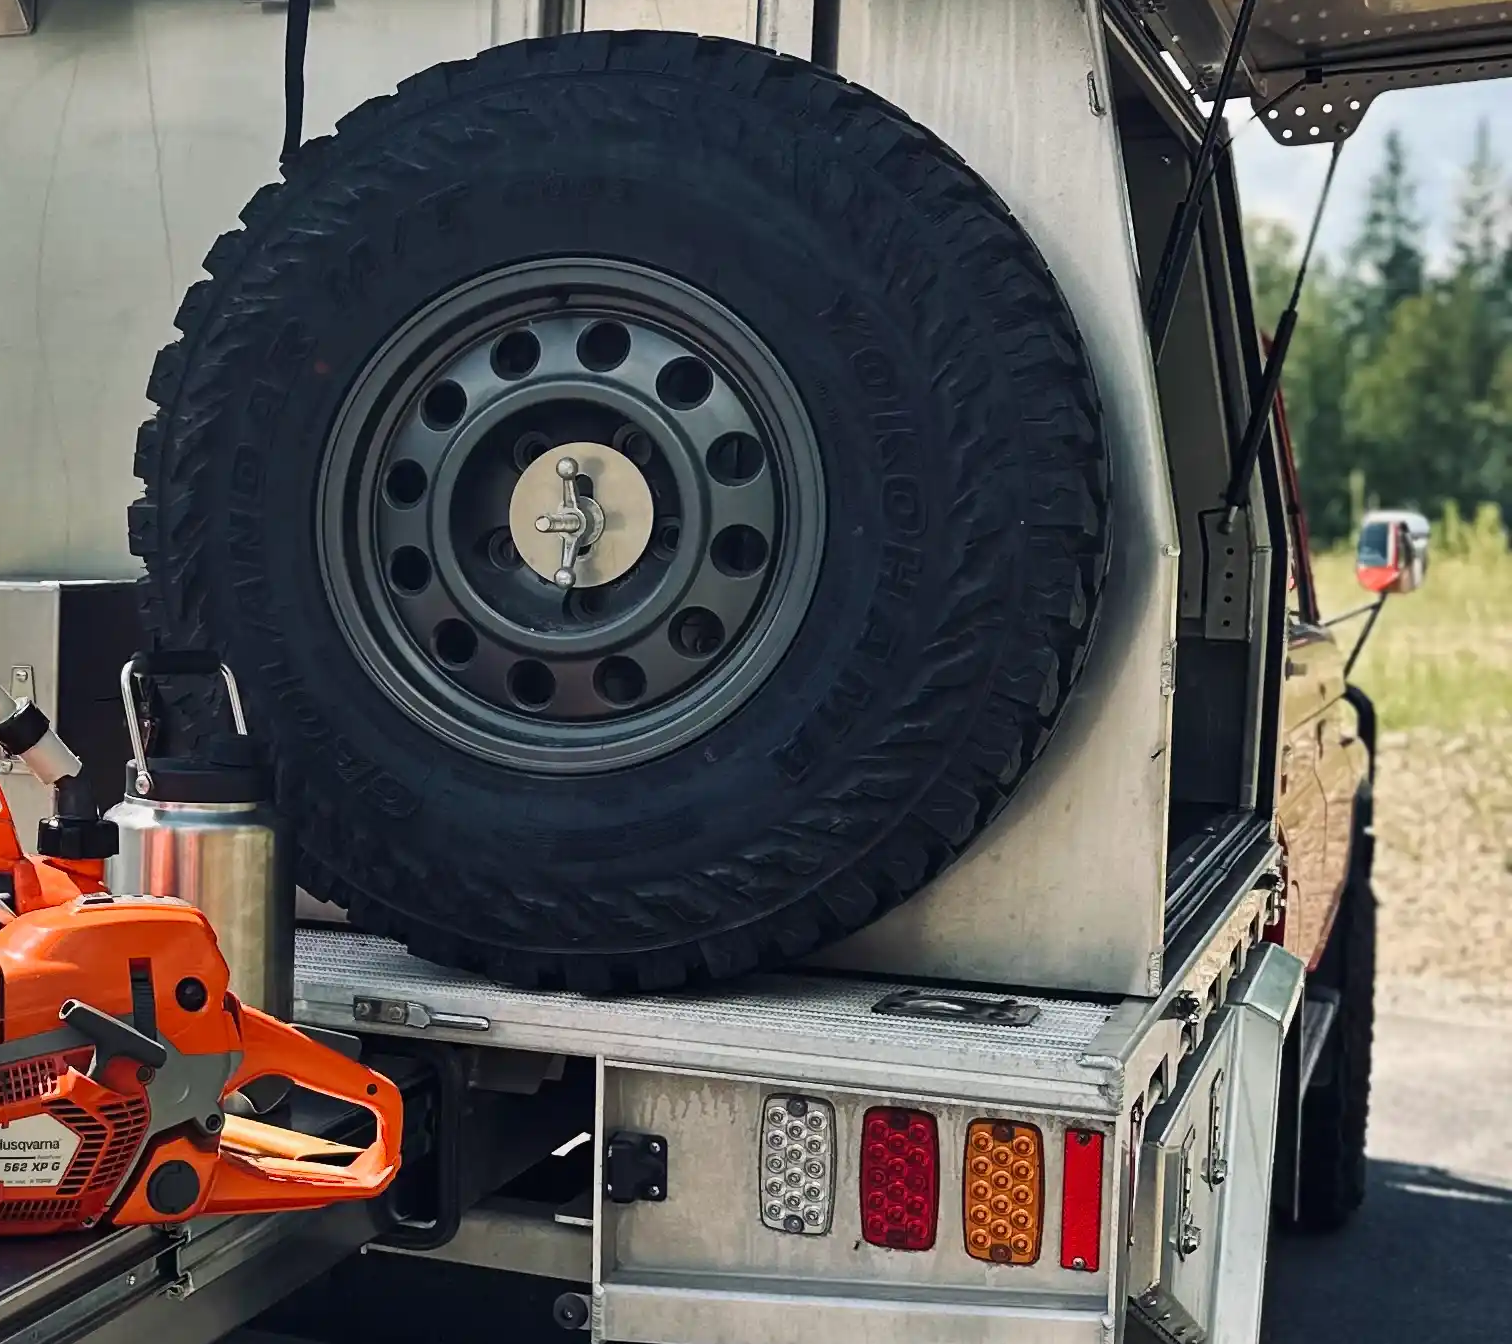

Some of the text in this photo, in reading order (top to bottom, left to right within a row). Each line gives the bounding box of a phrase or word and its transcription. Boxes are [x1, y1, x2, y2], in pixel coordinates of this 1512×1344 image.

[4, 1161, 61, 1172] 562 XP G
